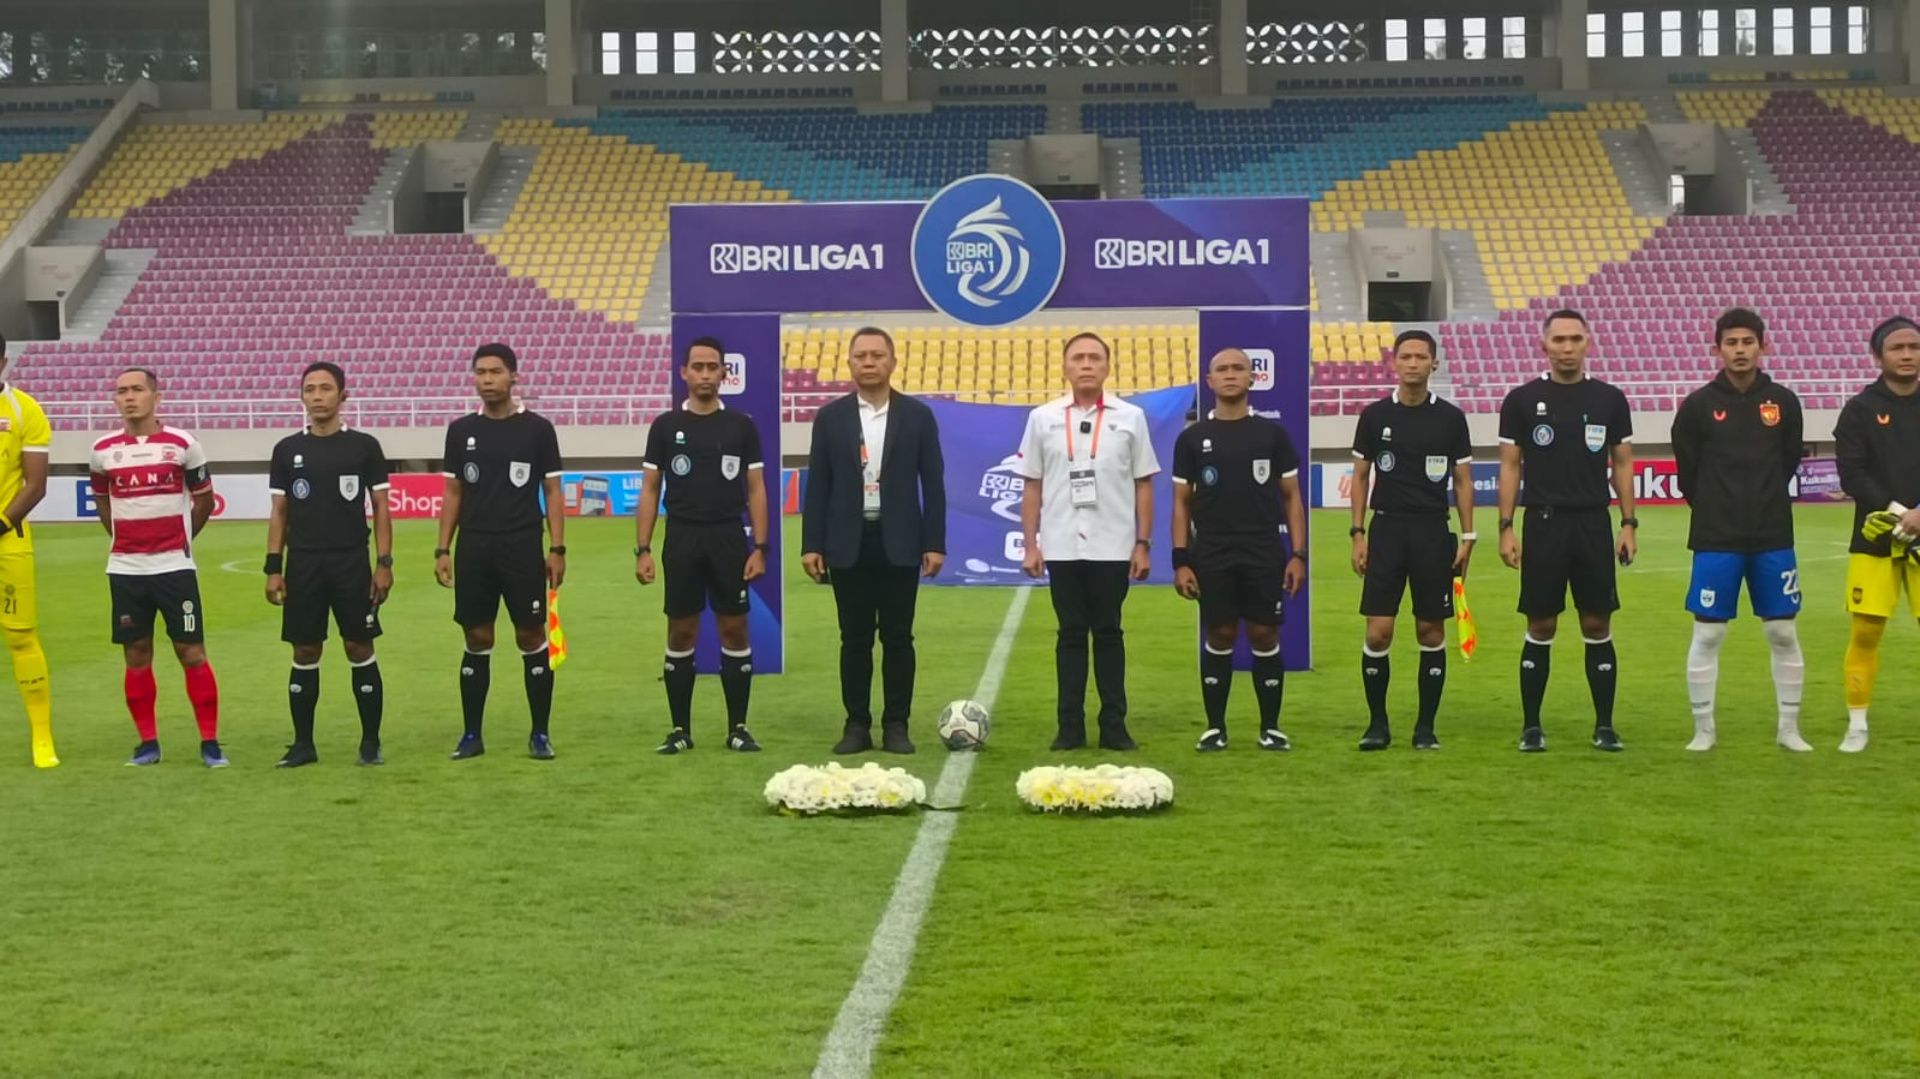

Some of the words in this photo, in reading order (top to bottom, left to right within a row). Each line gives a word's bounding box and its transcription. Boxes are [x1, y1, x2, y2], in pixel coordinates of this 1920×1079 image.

[742, 245, 789, 271] BRI
[966, 243, 993, 258] BRI
[1127, 240, 1174, 266] BRI
[724, 362, 739, 375] RI
[1251, 358, 1268, 371] RI
[4, 597, 17, 615] 21
[183, 614, 196, 632] 10
